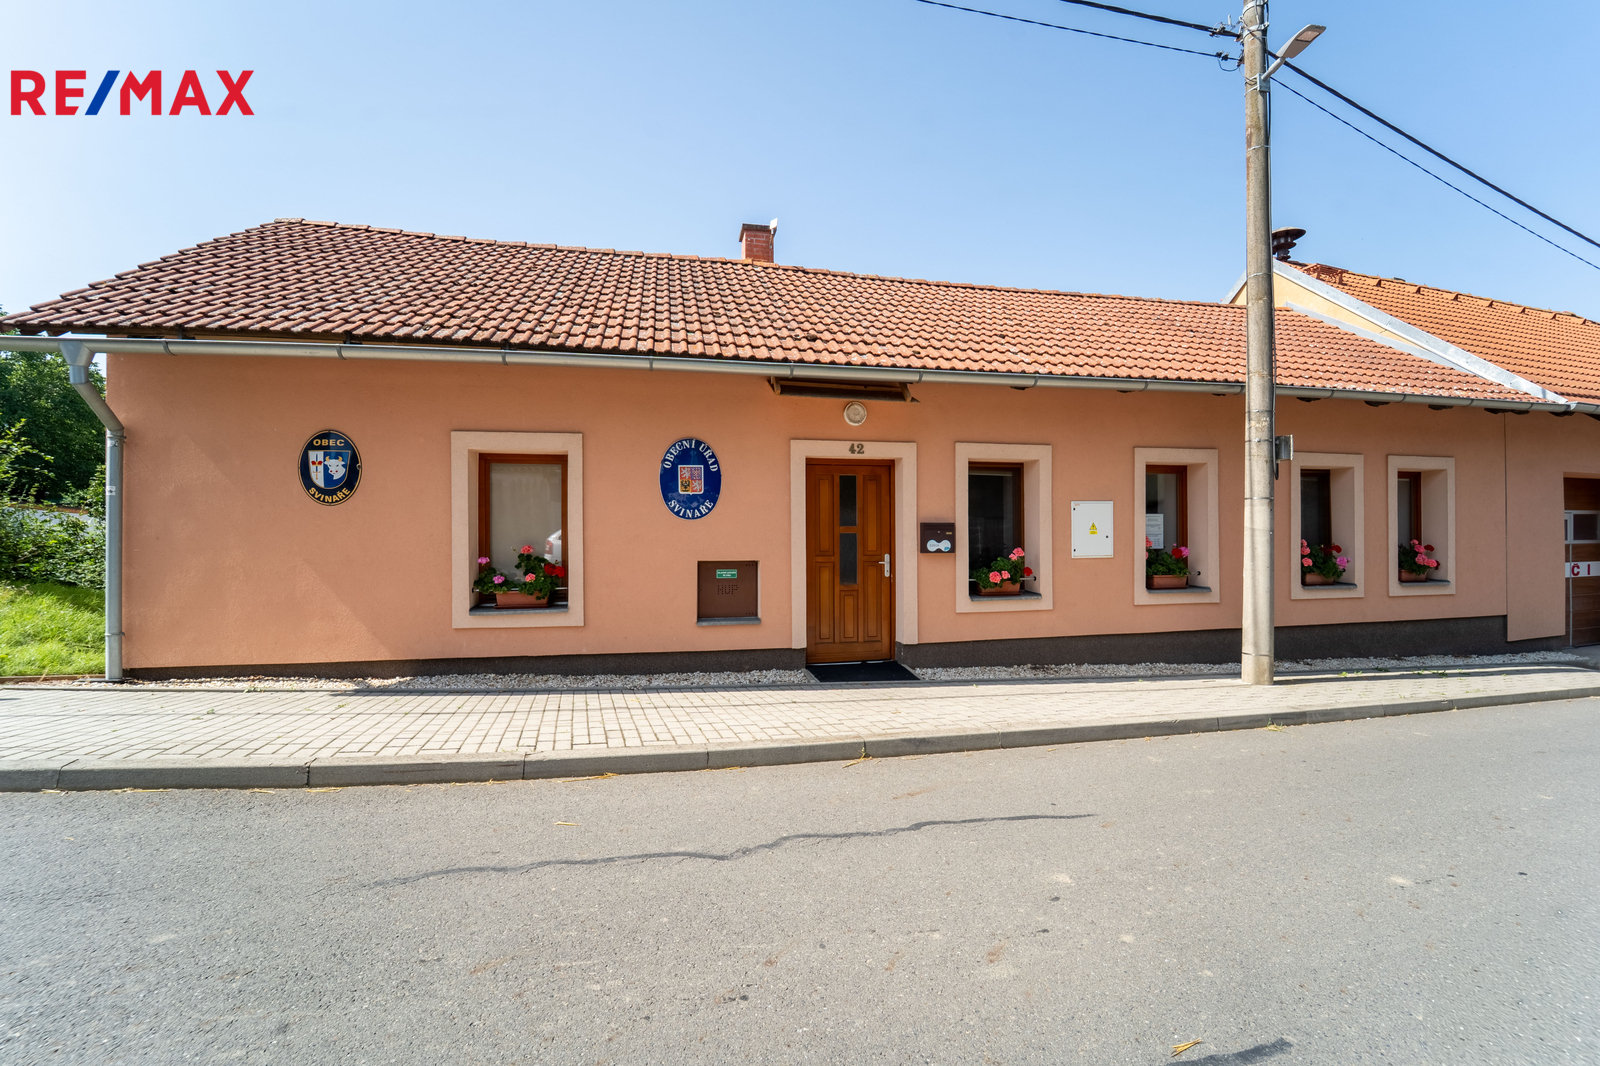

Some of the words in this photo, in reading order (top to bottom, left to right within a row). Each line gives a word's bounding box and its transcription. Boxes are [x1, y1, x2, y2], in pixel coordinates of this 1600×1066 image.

[663, 439, 696, 468] OBECNÍ
[849, 443, 865, 454] 42
[309, 487, 350, 502] SVINAŘE
[668, 500, 714, 518] SVINAŘE
[717, 584, 739, 595] HUP
